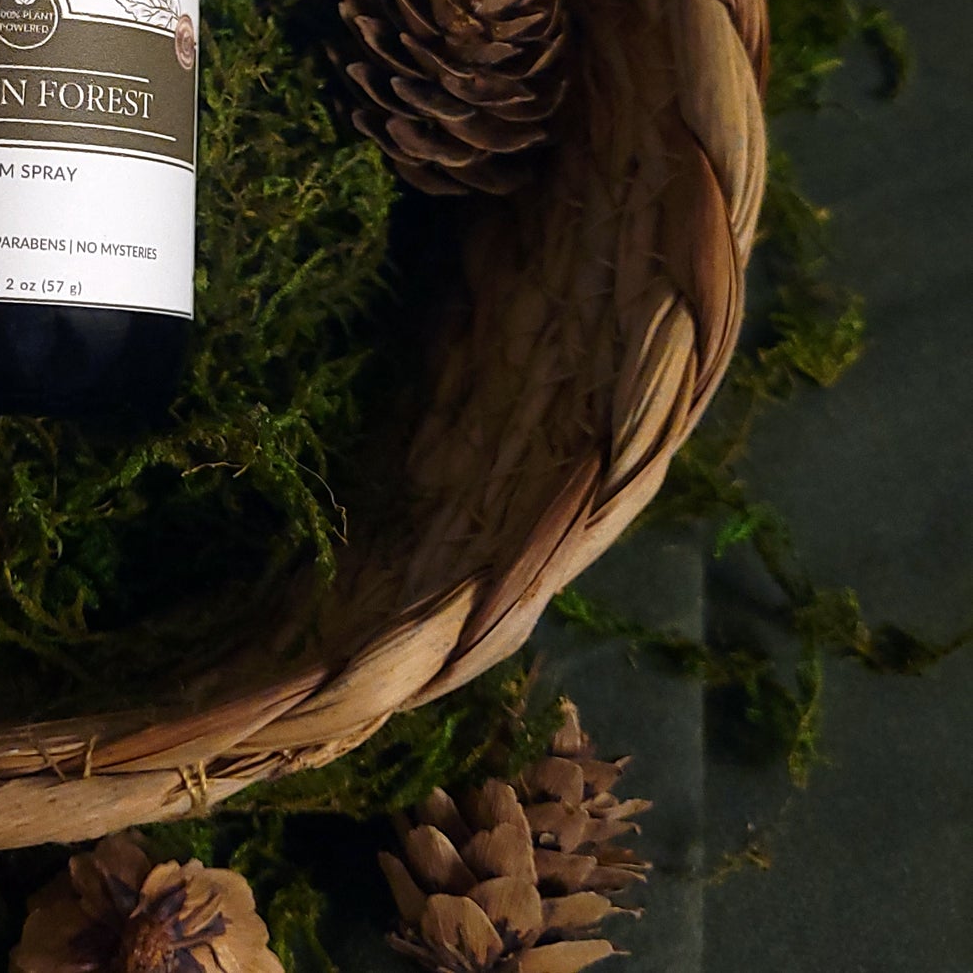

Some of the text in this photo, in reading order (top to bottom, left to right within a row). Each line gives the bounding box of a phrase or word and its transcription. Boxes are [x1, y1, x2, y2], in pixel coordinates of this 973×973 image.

[23, 10, 53, 21] PLANT
[0, 23, 49, 34] POWERED
[37, 78, 154, 119] FOREST
[20, 164, 77, 182] SPRAY
[76, 240, 97, 254] NO
[100, 242, 157, 260] MYSTERIES
[5, 278, 14, 290] 2
[20, 281, 36, 291] oz
[41, 279, 64, 294] (57
[70, 281, 82, 296] g)
